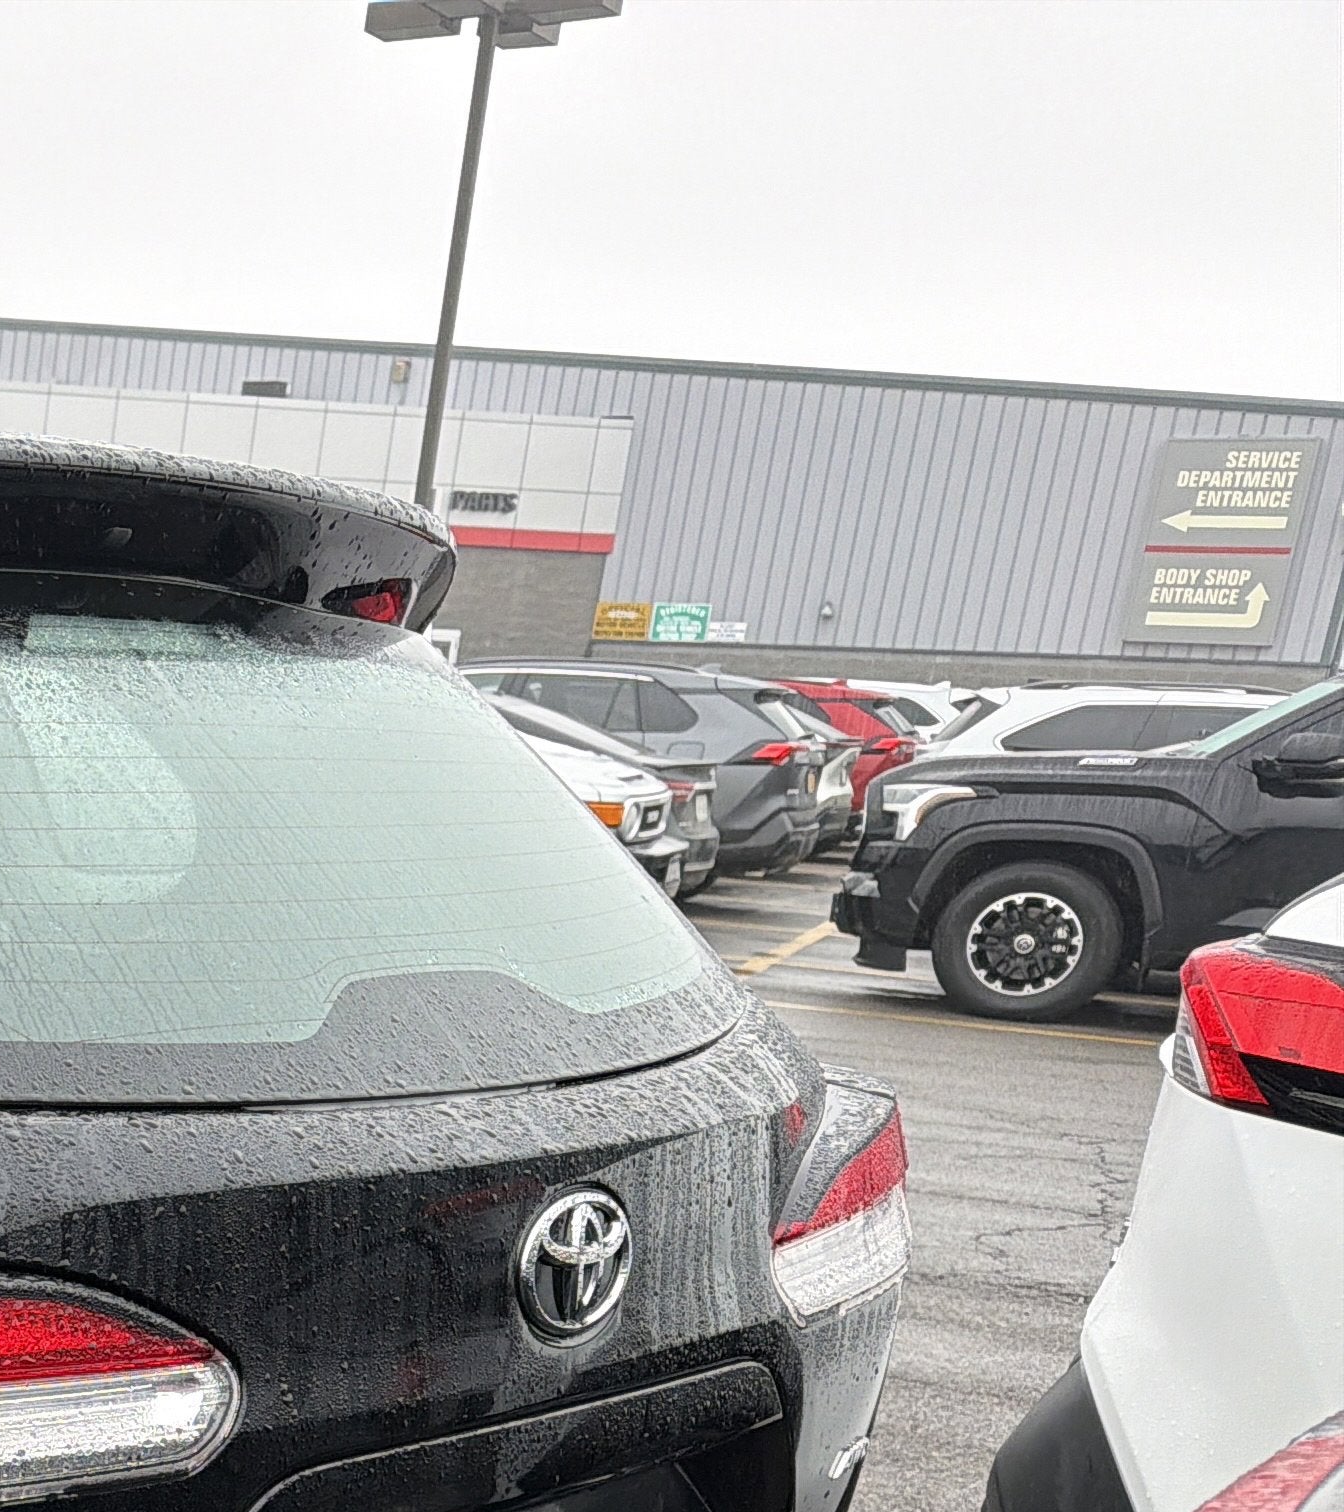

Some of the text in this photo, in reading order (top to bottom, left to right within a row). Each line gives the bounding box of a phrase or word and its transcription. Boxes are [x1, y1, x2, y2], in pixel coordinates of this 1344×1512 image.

[1225, 451, 1302, 468] SERVICE
[1177, 471, 1298, 488] DEPARTMENT
[1196, 491, 1292, 508] ENTRANCE
[1154, 568, 1251, 586] BODY SHOP
[1150, 587, 1240, 605] ENTRANCE
